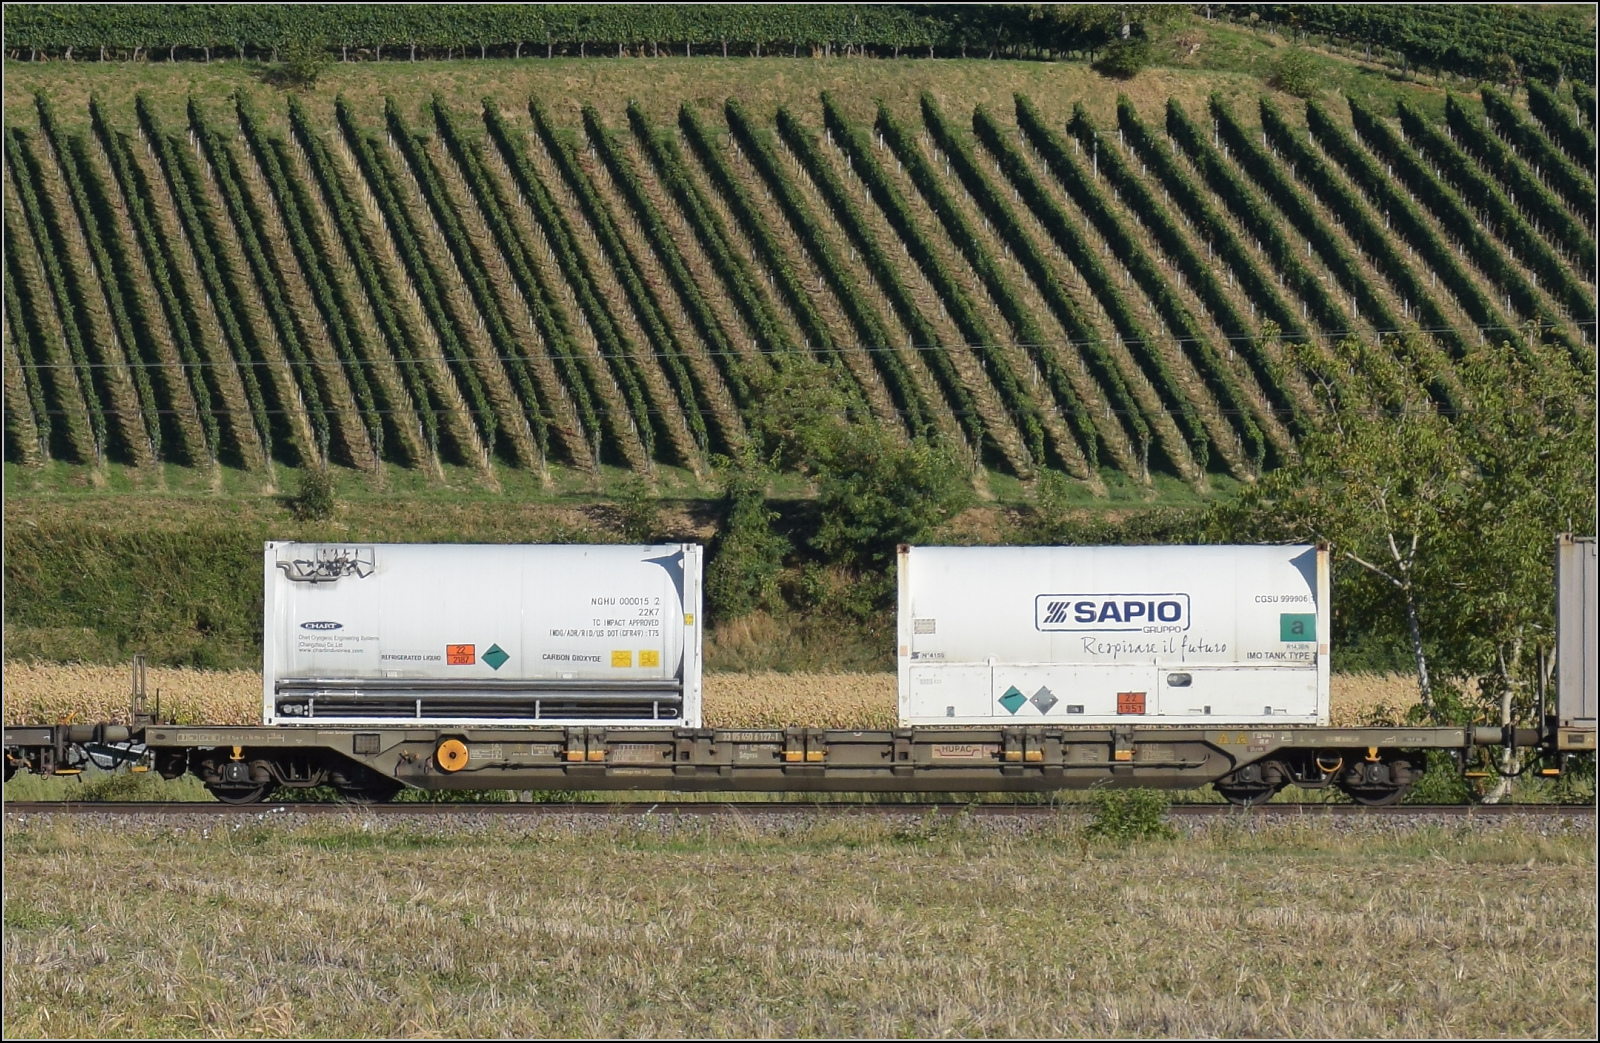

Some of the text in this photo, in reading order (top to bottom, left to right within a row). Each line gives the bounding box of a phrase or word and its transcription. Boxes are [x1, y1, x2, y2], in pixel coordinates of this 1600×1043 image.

[591, 597, 660, 606] NGHU 000015 2
[1254, 595, 1279, 603] CGSU
[1280, 595, 1308, 603] 999906
[638, 608, 660, 617] 22K7
[1074, 601, 1182, 623] SAPIO
[593, 619, 660, 627] TC IMPACT APPROVED
[1143, 626, 1181, 634] GRUPPO
[1291, 620, 1305, 635] a
[456, 646, 466, 654] 22
[1081, 635, 1227, 663] Respirare il futuro
[542, 653, 570, 661] CARBON
[1246, 651, 1263, 660] IMO
[1264, 651, 1287, 660] TANK
[1289, 651, 1310, 660] TYPE
[453, 656, 469, 664] 2187
[1125, 694, 1137, 702] 22
[1119, 705, 1142, 713] 1951
[941, 745, 972, 753] HUPAC
